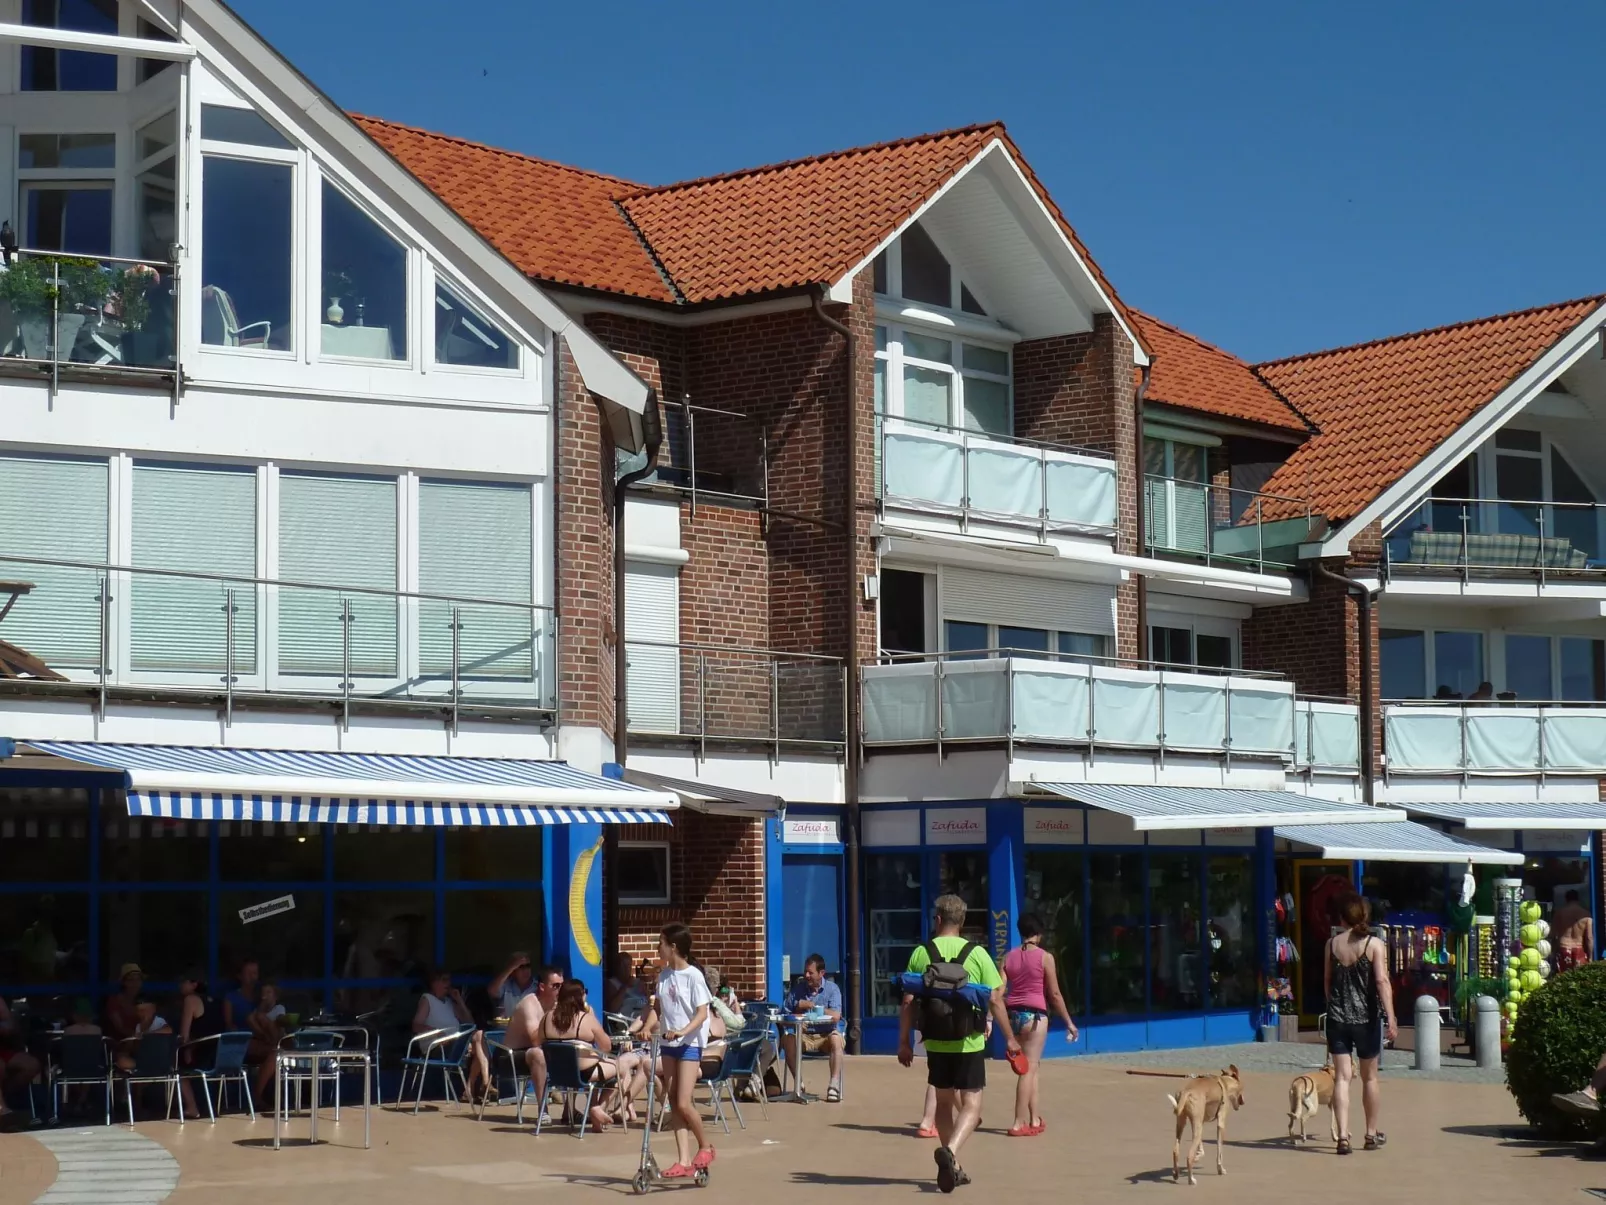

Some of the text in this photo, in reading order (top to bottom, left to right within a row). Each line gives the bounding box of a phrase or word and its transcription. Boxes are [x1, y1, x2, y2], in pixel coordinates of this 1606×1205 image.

[792, 822, 832, 833] Zafuda
[932, 819, 979, 832] Zafuda
[1035, 819, 1071, 831] Zafuda
